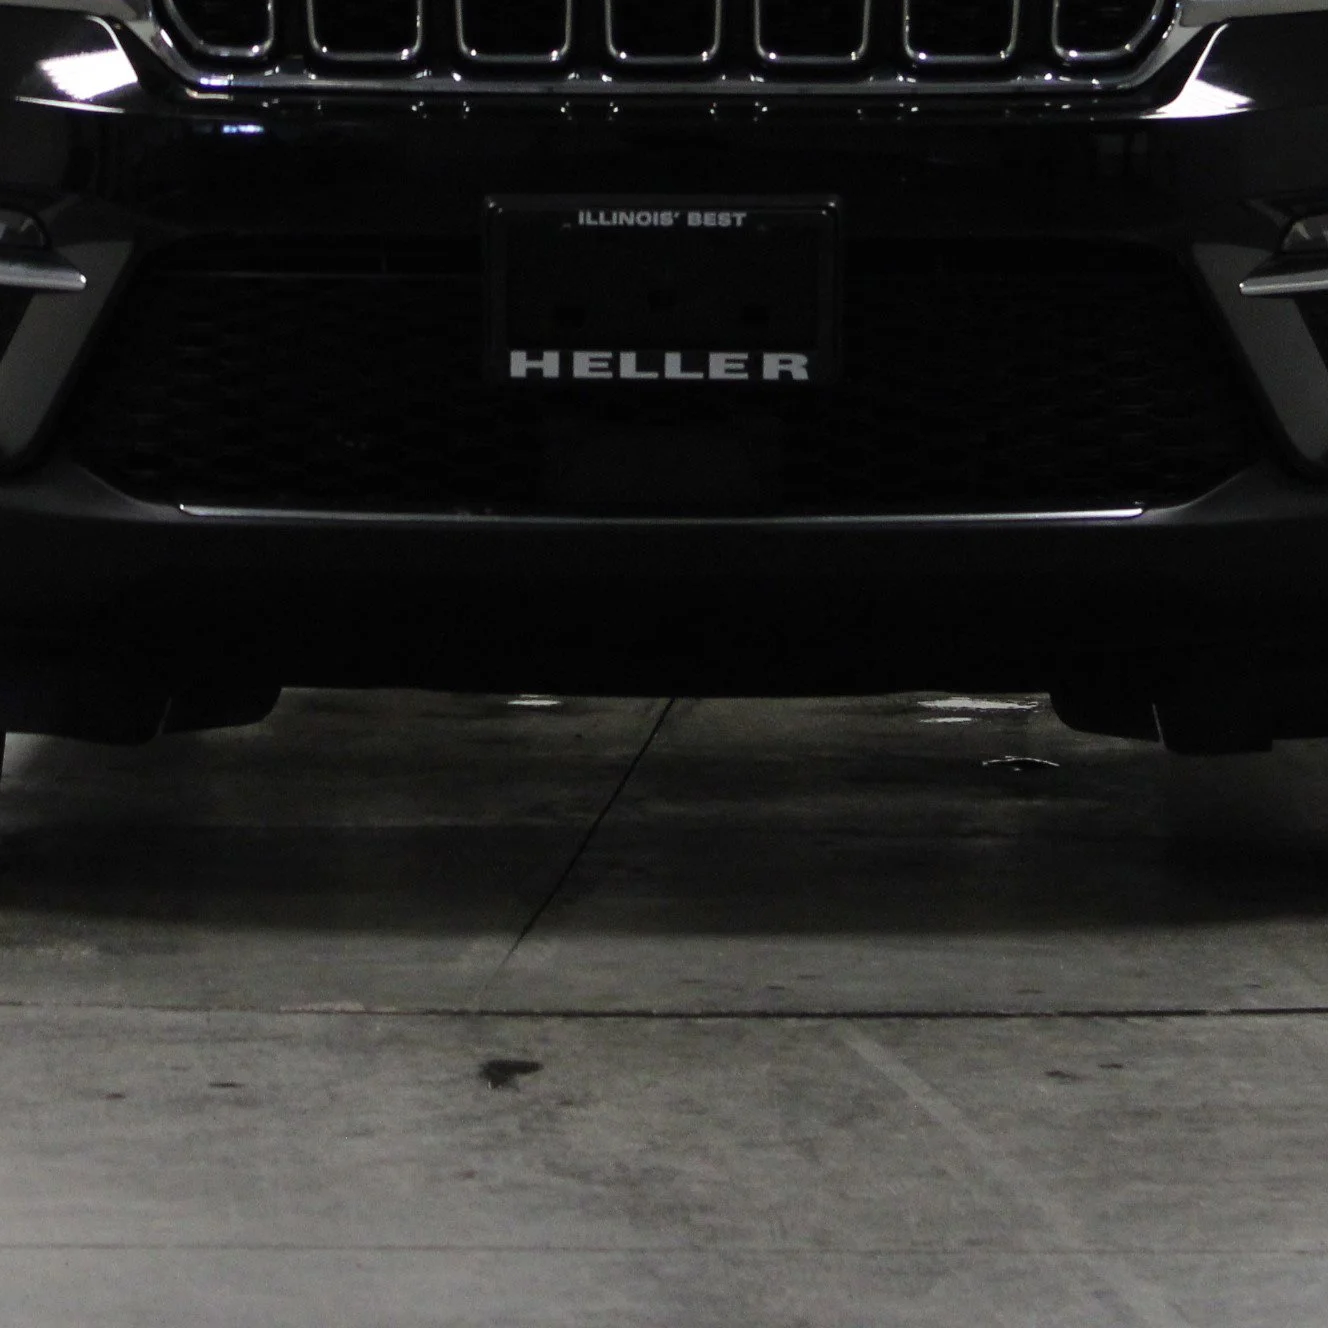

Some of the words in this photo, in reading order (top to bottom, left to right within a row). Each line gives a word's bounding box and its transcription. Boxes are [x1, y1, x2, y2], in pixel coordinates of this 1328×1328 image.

[577, 209, 680, 227] ILLINOIS'
[687, 210, 748, 228] BEST
[509, 350, 810, 381] HELLER
